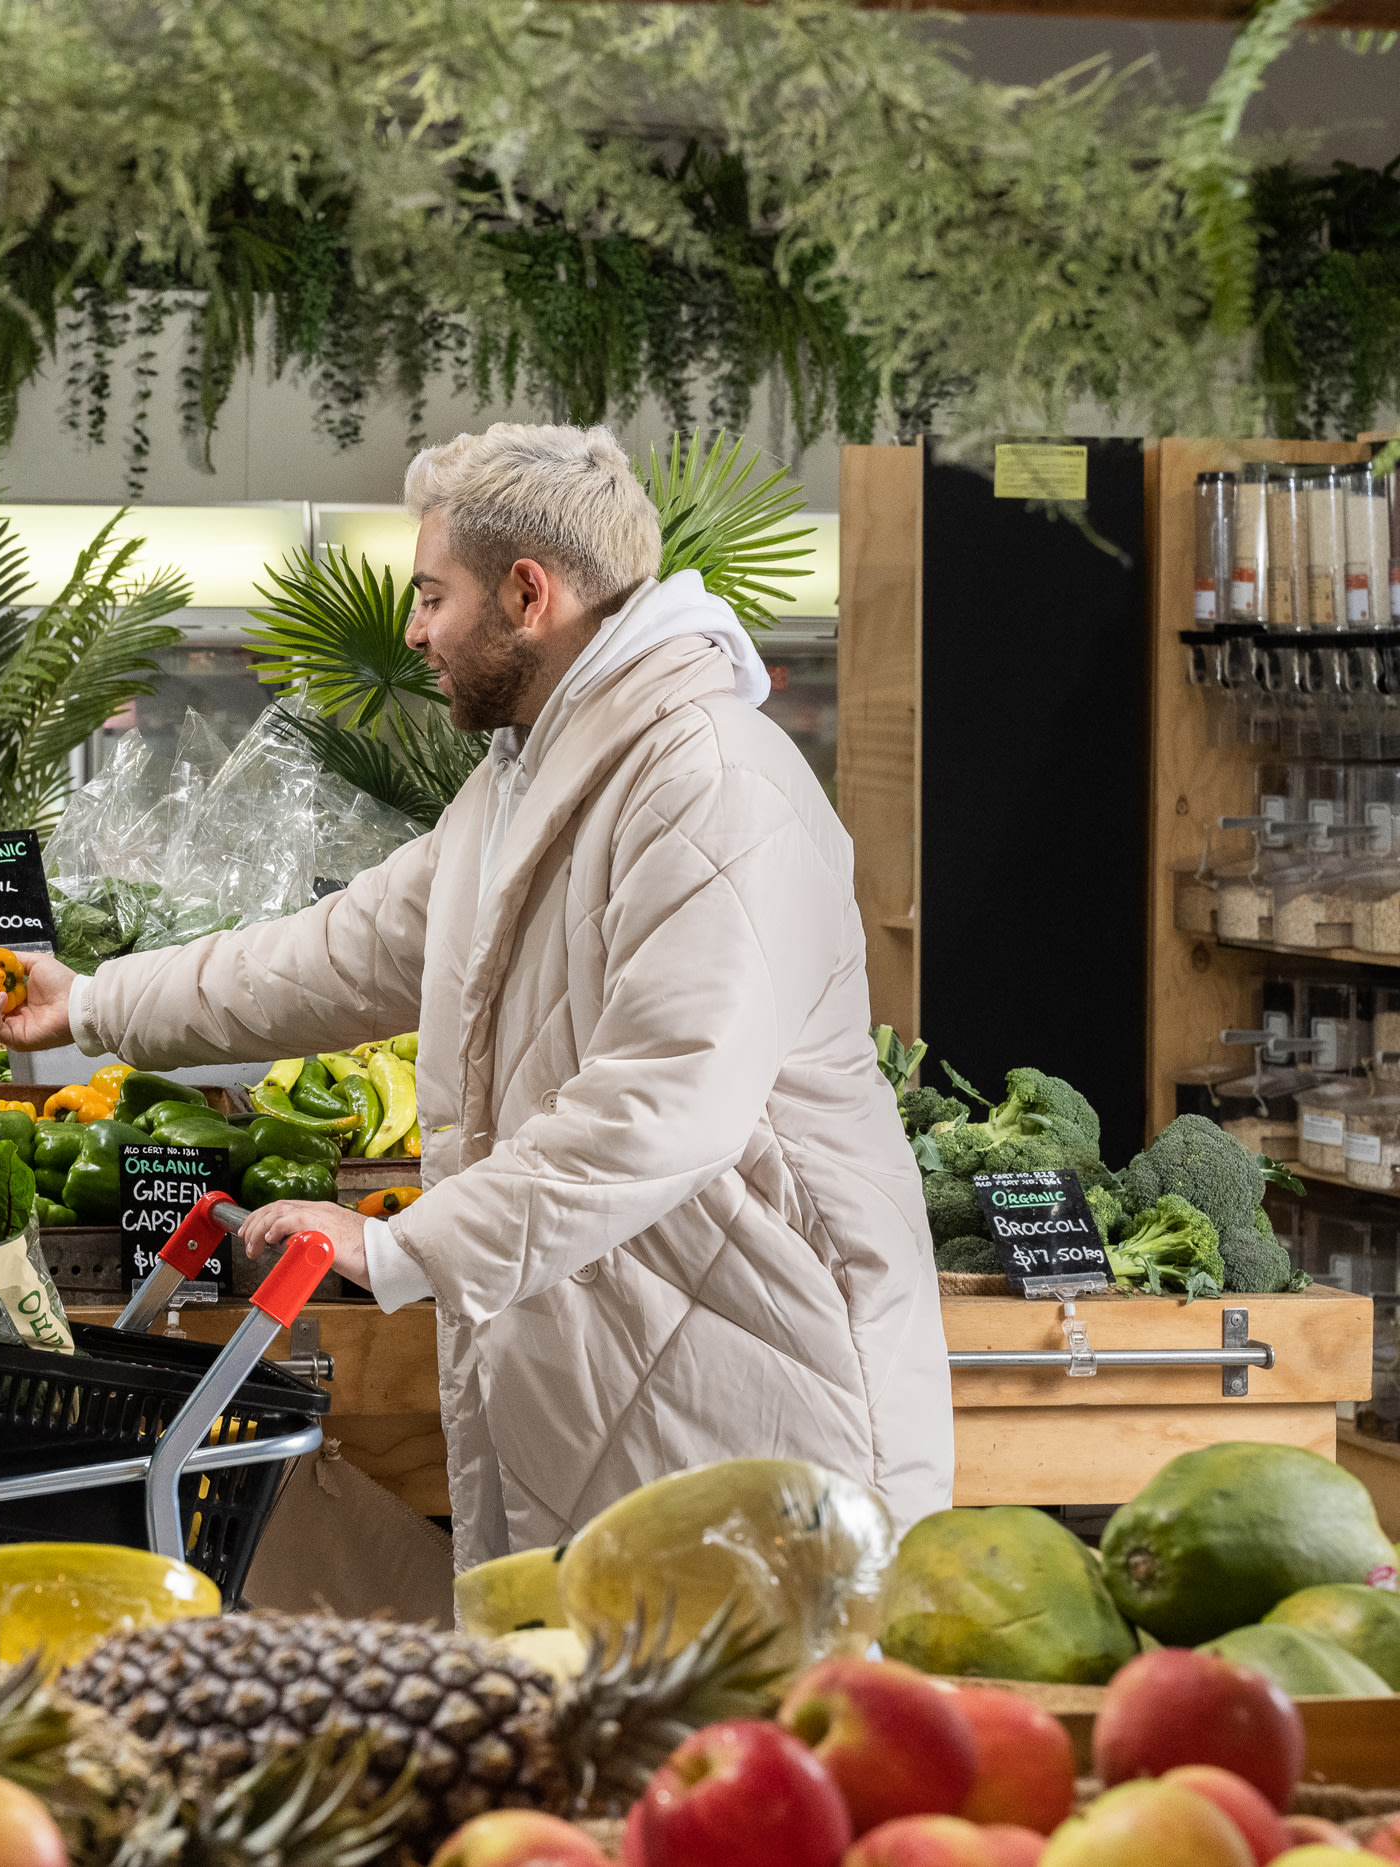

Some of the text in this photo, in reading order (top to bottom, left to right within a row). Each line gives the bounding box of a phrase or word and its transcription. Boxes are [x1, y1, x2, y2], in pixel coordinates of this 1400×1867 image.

[124, 1146, 139, 1154] ACO
[142, 1146, 164, 1155] CERT
[125, 1157, 212, 1176] ORGANIC
[133, 1179, 207, 1205] GREEN
[991, 1190, 1067, 1207] ORGANIC
[122, 1209, 190, 1234] CAPSI
[993, 1215, 1089, 1237] BROCCOLI
